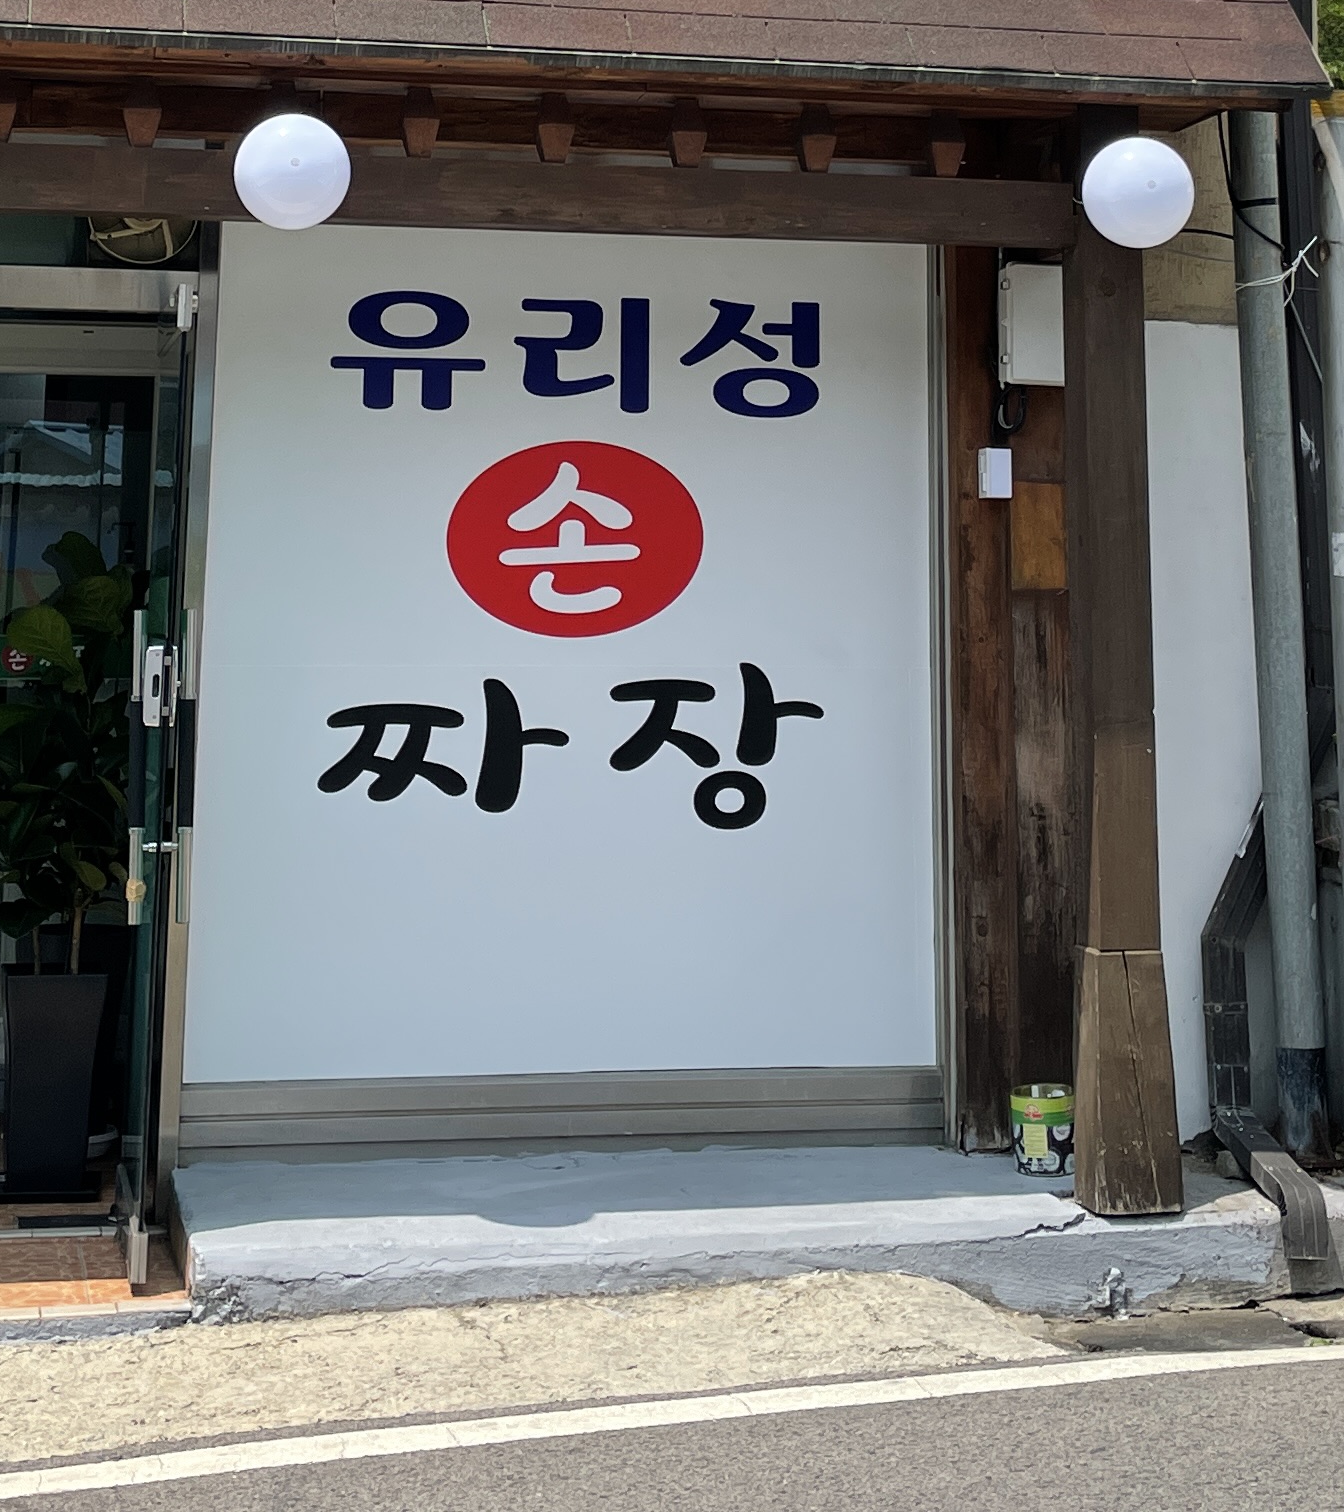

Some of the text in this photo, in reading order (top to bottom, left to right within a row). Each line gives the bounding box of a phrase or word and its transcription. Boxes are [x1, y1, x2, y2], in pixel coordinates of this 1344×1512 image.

[330, 290, 821, 419] 유리성
[498, 461, 642, 615] 손
[7, 649, 28, 671] 손
[317, 662, 825, 831] 짜장
